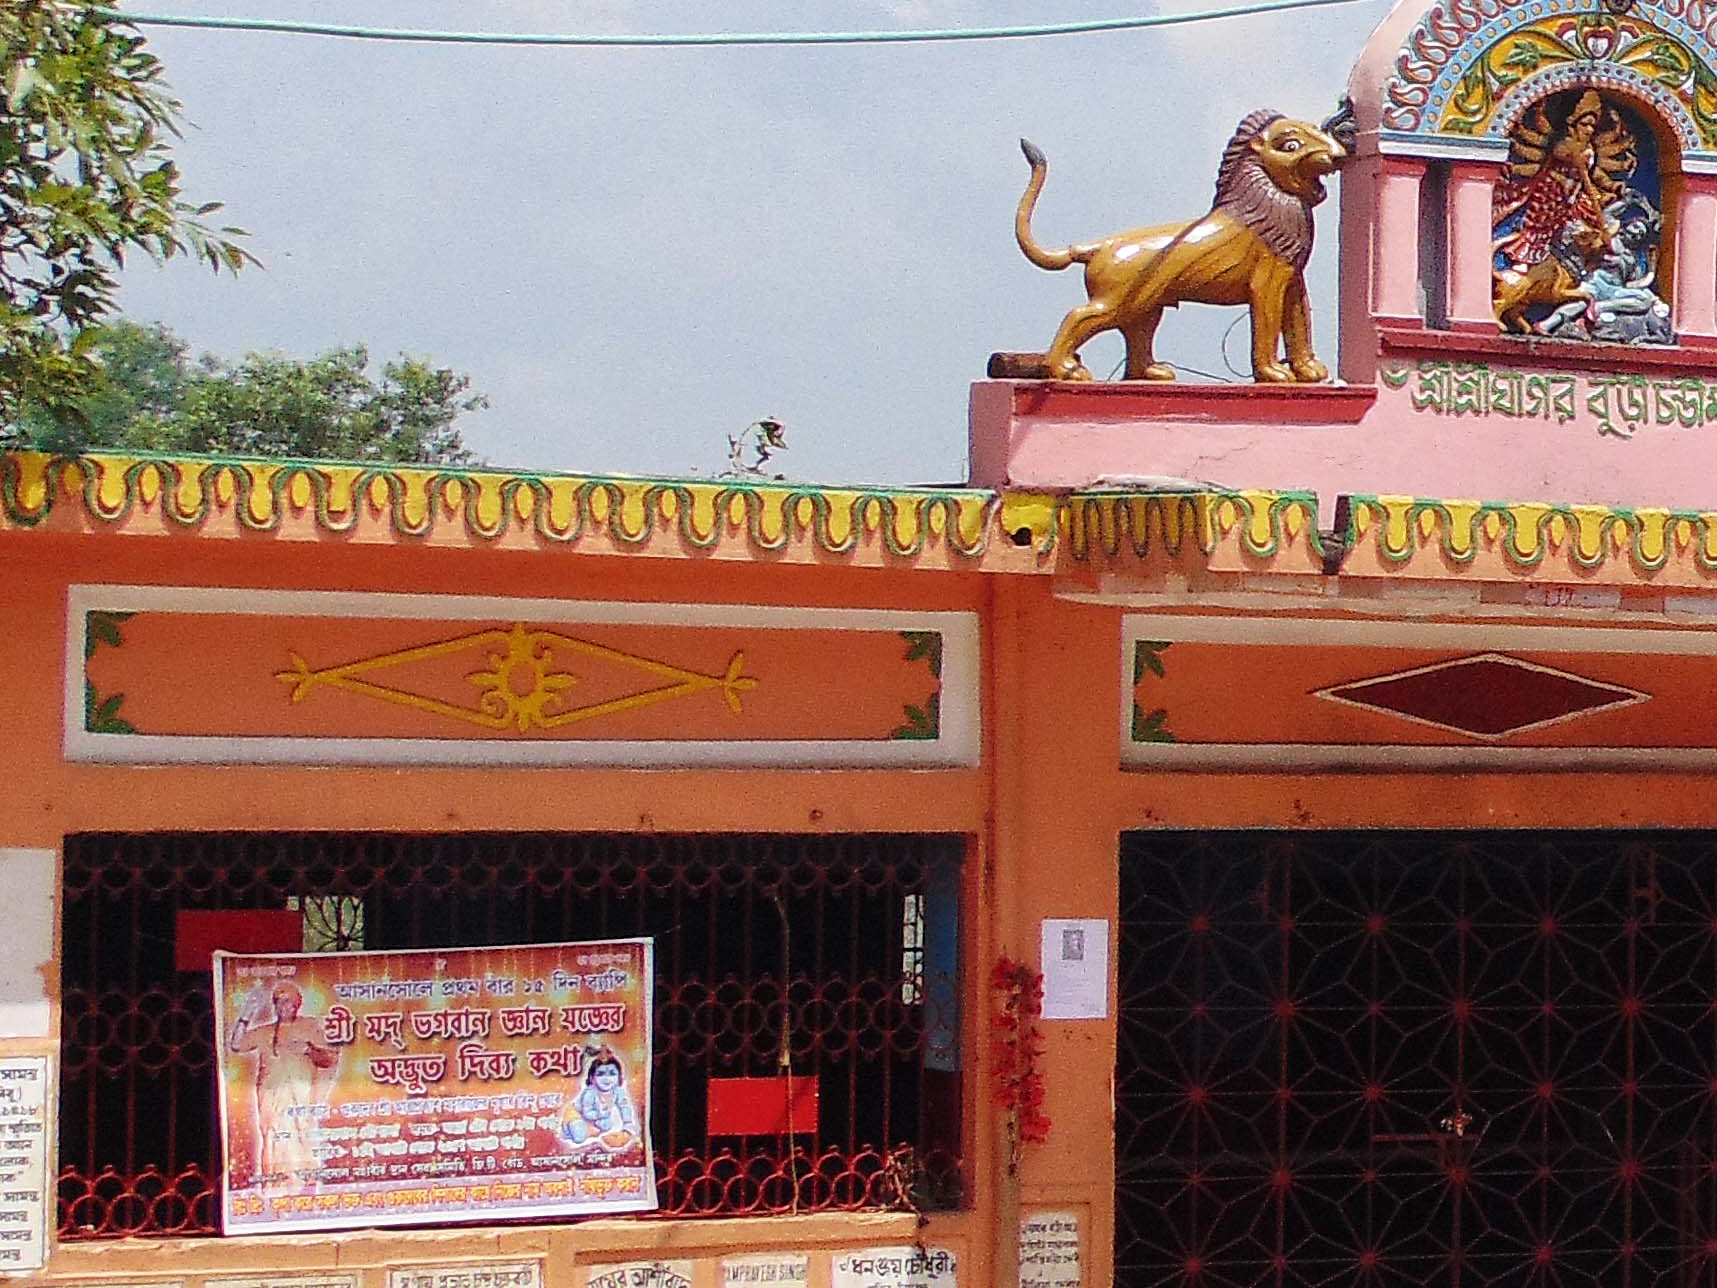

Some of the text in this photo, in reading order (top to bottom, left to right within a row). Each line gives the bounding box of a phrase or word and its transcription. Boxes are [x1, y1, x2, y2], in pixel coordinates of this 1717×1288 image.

[441, 980, 481, 998] প্রথম
[487, 975, 514, 996] বার
[551, 969, 582, 994] দিন
[322, 1006, 354, 1044] শ্রী
[412, 1007, 490, 1039] ভগবান
[499, 1005, 550, 1036] জ্ঞান
[559, 1001, 628, 1033] যজ্ঞের
[457, 1044, 515, 1082] দিব্য
[525, 1045, 585, 1077] কথা
